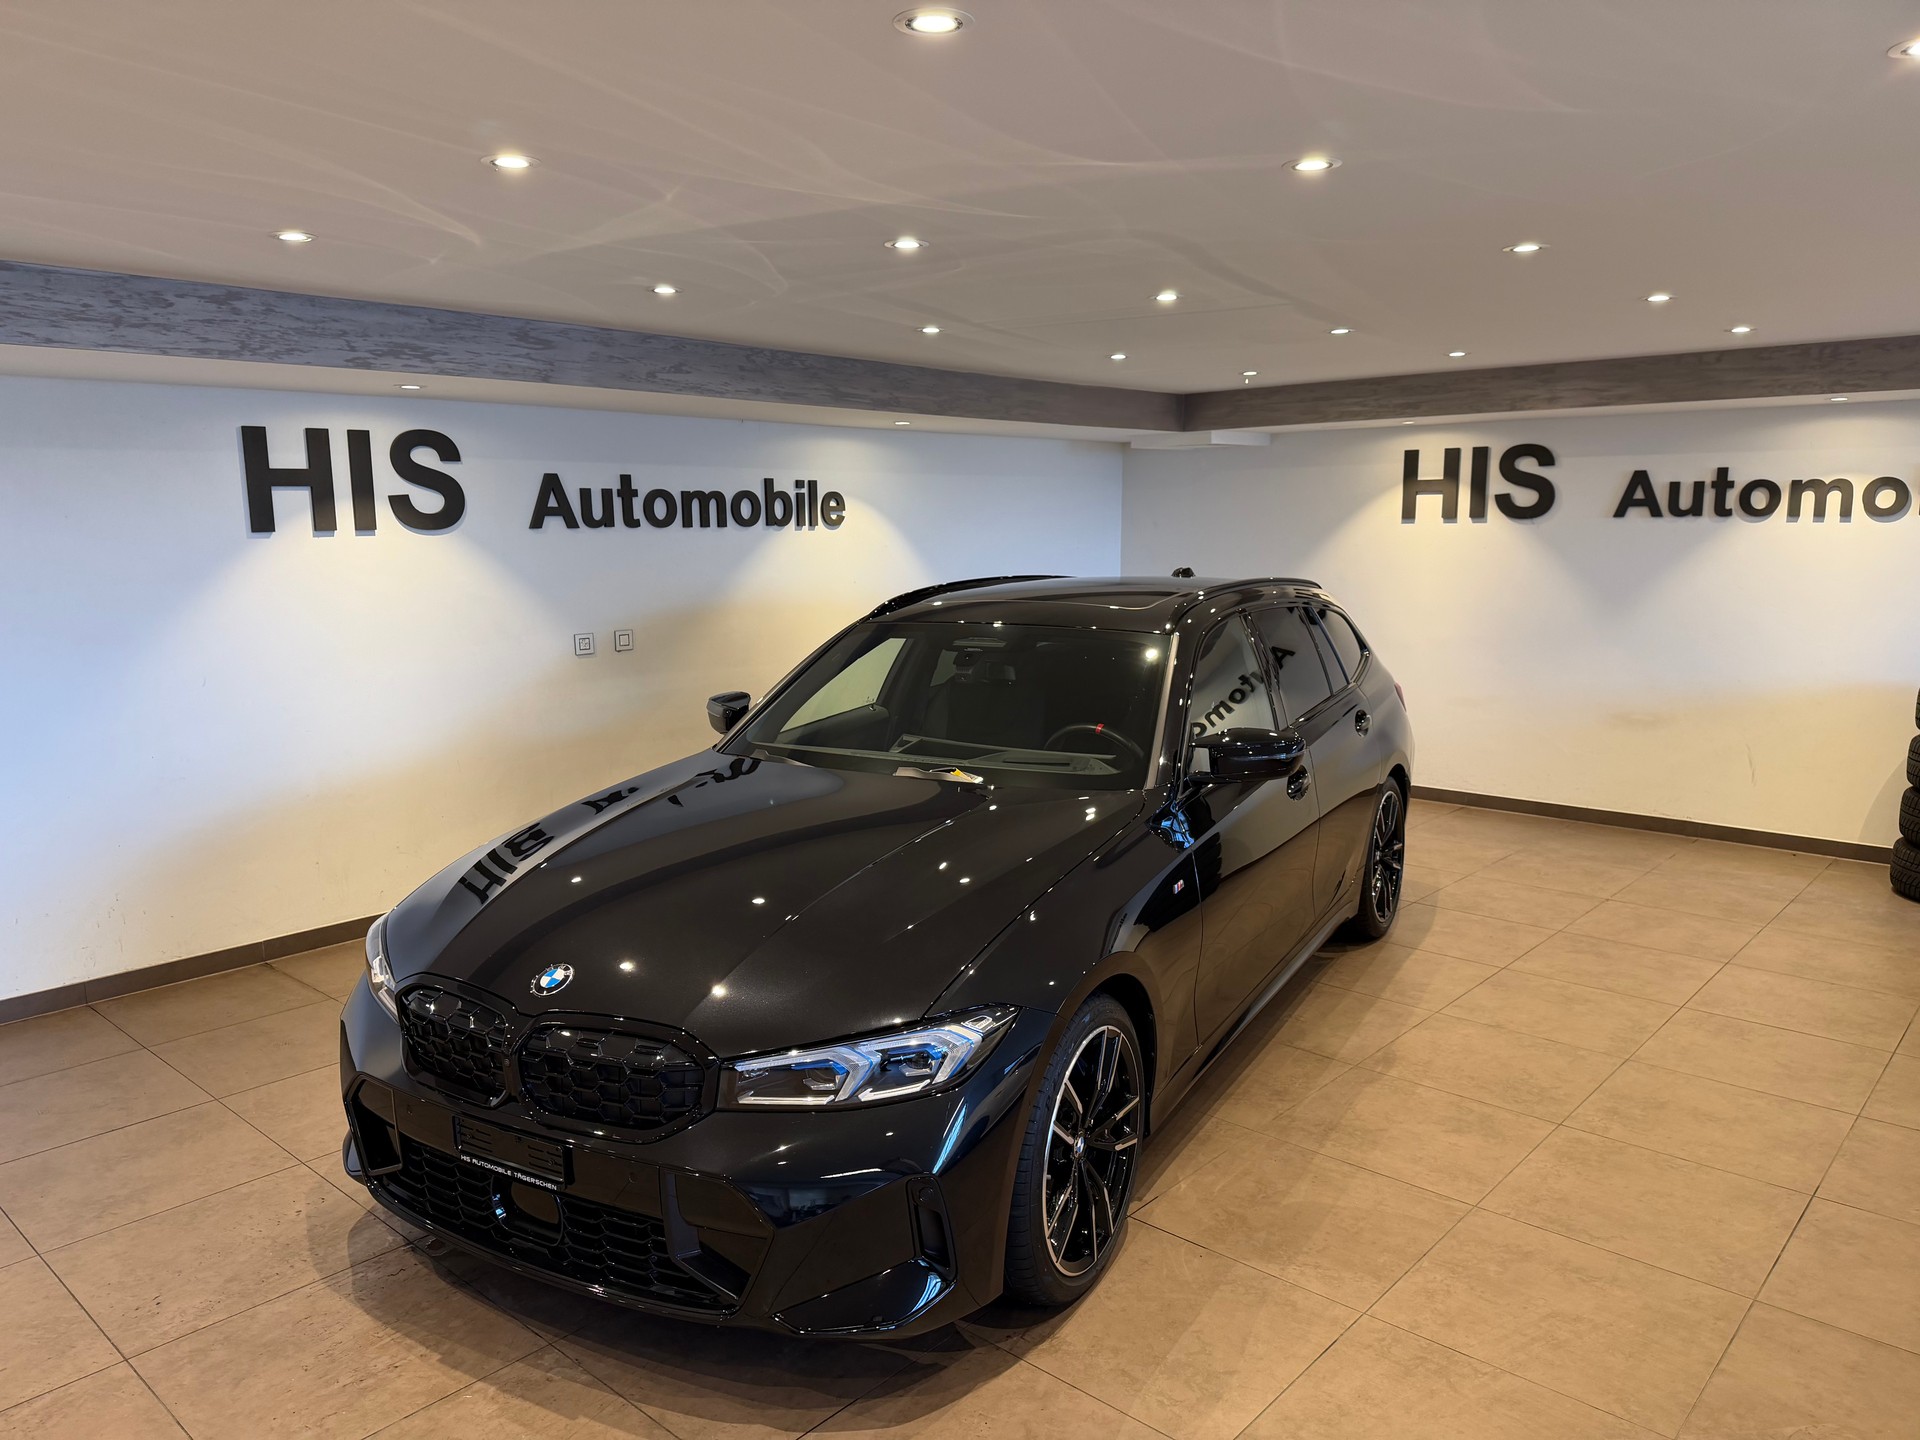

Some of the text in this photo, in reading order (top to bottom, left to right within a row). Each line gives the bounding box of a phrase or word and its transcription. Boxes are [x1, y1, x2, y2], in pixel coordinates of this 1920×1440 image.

[240, 425, 847, 534] HIS Automobile
[1401, 443, 1920, 520] HIS Automo
[460, 1154, 471, 1163] HIS
[472, 1158, 512, 1176] AUTOMOBILE
